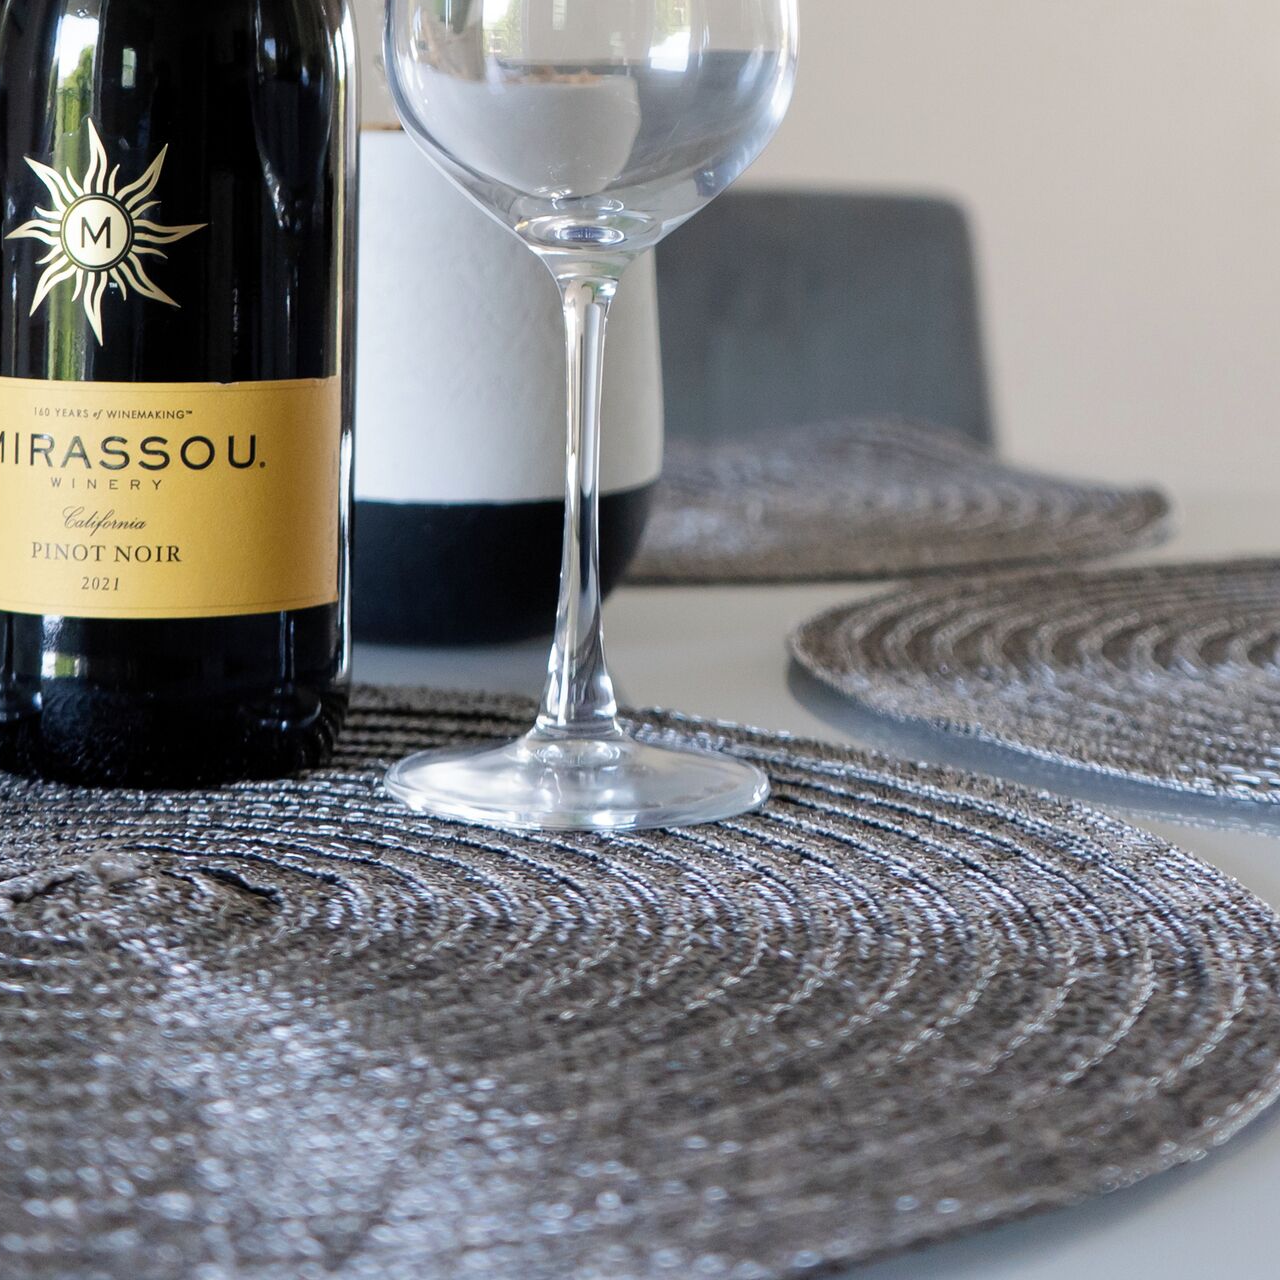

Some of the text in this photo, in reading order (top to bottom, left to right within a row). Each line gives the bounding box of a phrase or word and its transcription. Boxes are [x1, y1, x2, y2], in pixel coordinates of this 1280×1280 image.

[81, 216, 111, 249] M
[34, 407, 50, 417] 160
[55, 408, 89, 418] YEARS
[92, 409, 103, 420] of
[50, 477, 162, 491] WINERY
[62, 506, 146, 537] California
[32, 541, 182, 563] PINOT NOIR
[81, 576, 120, 592] 2021
